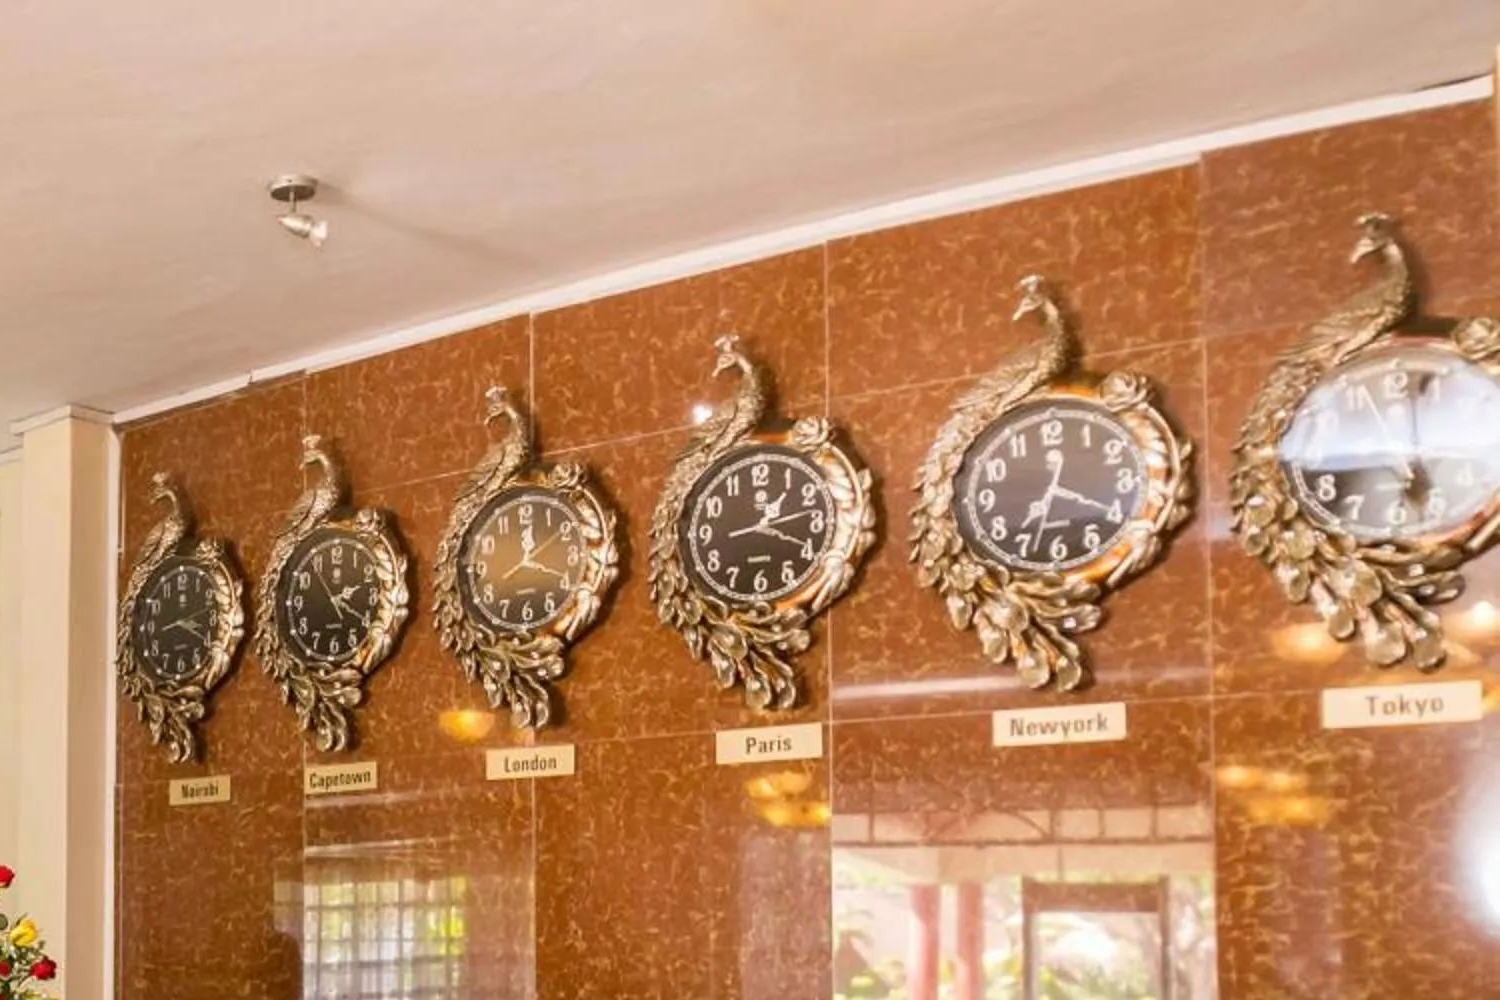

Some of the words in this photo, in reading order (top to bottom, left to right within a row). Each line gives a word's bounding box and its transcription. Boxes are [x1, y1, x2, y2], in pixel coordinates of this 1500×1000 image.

[1383, 373, 1409, 399] 12
[1041, 420, 1063, 445] 12
[1082, 424, 1091, 448] 1
[1010, 434, 1027, 458] 11
[1104, 439, 1123, 465] 2
[752, 464, 769, 487] 12
[785, 468, 791, 490] 1
[986, 458, 1006, 483] 10
[1117, 468, 1134, 494] 3
[726, 475, 739, 496] 11
[802, 483, 816, 507] 2
[1318, 474, 1336, 501] 8
[706, 496, 722, 518] 10
[979, 489, 995, 513] 9
[1344, 495, 1365, 521] 7
[546, 508, 551, 527] 1
[809, 510, 824, 533] 3
[1106, 500, 1122, 524] 4
[1386, 501, 1406, 526] 6
[498, 516, 509, 535] 11
[560, 521, 571, 541] 2
[700, 525, 713, 546] 9
[991, 516, 1007, 541] 8
[1015, 533, 1031, 557] 7
[1051, 535, 1067, 560] 6
[1084, 524, 1100, 550] 5
[353, 551, 357, 568] 1
[567, 545, 578, 566] 3
[801, 538, 812, 560] 4
[476, 561, 486, 578] 9
[707, 550, 720, 572] 8
[782, 560, 794, 583] 5
[300, 572, 310, 589] 10
[364, 564, 373, 583] 2
[560, 571, 569, 590] 4
[726, 567, 739, 588] 7
[754, 570, 768, 592] 6
[164, 583, 170, 598] 11
[484, 584, 493, 603] 8
[294, 595, 303, 612] 9
[500, 599, 510, 618] 7
[522, 601, 533, 620] 6
[544, 592, 555, 612] 5
[300, 618, 308, 635] 8
[362, 610, 370, 628] 4
[152, 640, 159, 656] 8
[312, 632, 320, 650] 7
[330, 635, 339, 653] 6
[348, 629, 357, 646] 5
[163, 654, 170, 669] 7
[178, 655, 184, 672] 6
[1365, 694, 1444, 718] Tokyo
[1009, 712, 1109, 740] Newyork
[745, 735, 792, 755] Paris
[503, 756, 558, 774] London
[309, 771, 371, 791] Capetown
